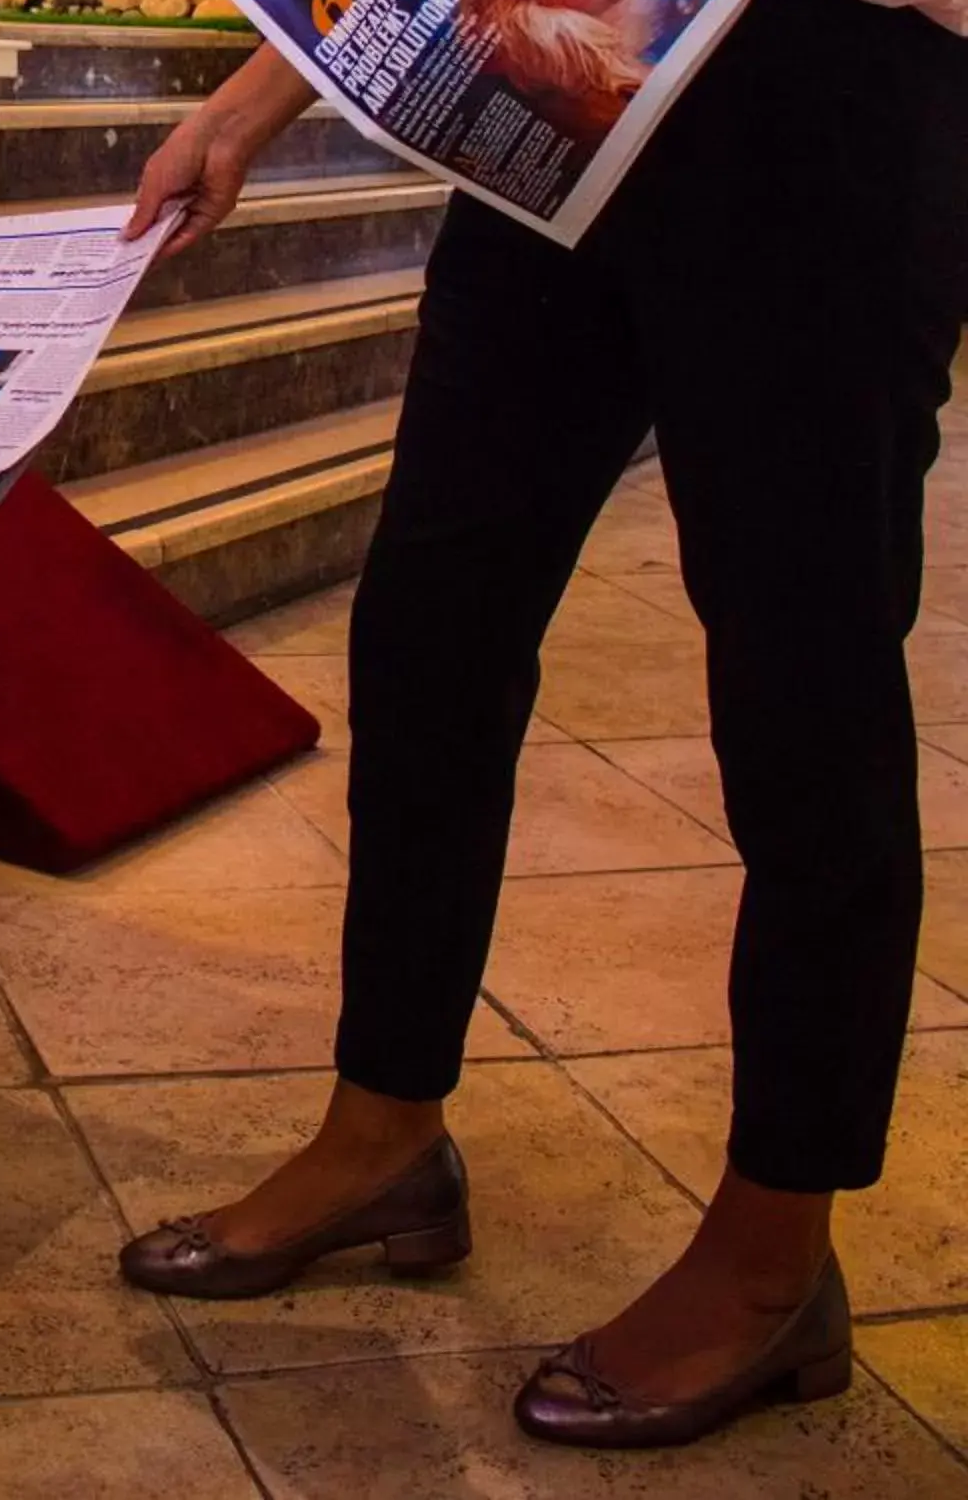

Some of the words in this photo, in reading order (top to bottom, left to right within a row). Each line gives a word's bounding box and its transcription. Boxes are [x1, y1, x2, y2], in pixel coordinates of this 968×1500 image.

[326, 42, 362, 80] PET
[335, 2, 417, 97] PROBLEMS
[355, 66, 402, 116] AND
